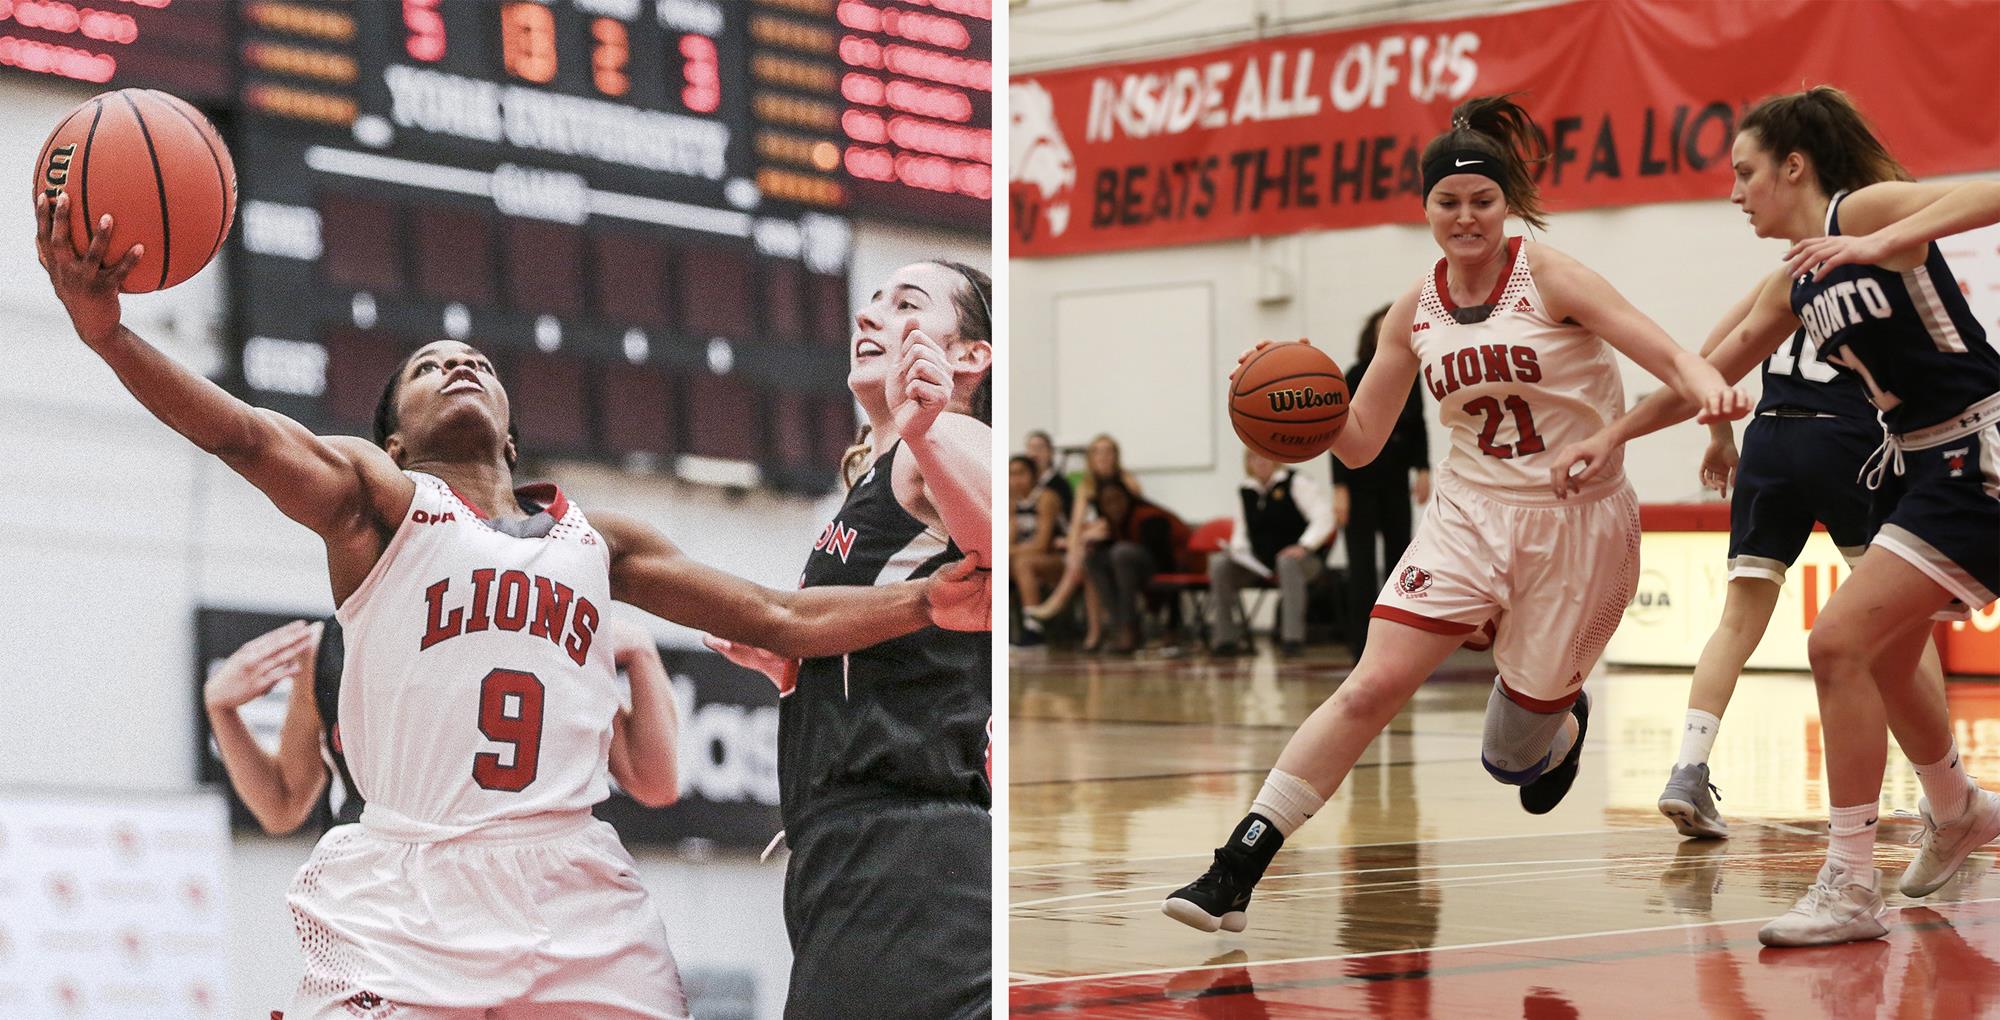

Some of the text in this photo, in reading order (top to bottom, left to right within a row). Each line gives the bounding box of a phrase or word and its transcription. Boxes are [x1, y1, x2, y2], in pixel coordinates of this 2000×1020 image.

[1086, 32, 1480, 143] INSIDE ALL OF US
[1091, 153, 1217, 228] BEATS
[1230, 143, 1321, 213] THE
[1585, 113, 1620, 182] A
[1799, 277, 1892, 350] RONTO
[1267, 386, 1343, 413] Wilson
[1424, 344, 1542, 402] LIONS
[1462, 394, 1546, 459] 21
[420, 568, 600, 667] LIONS
[472, 668, 545, 793] 9
